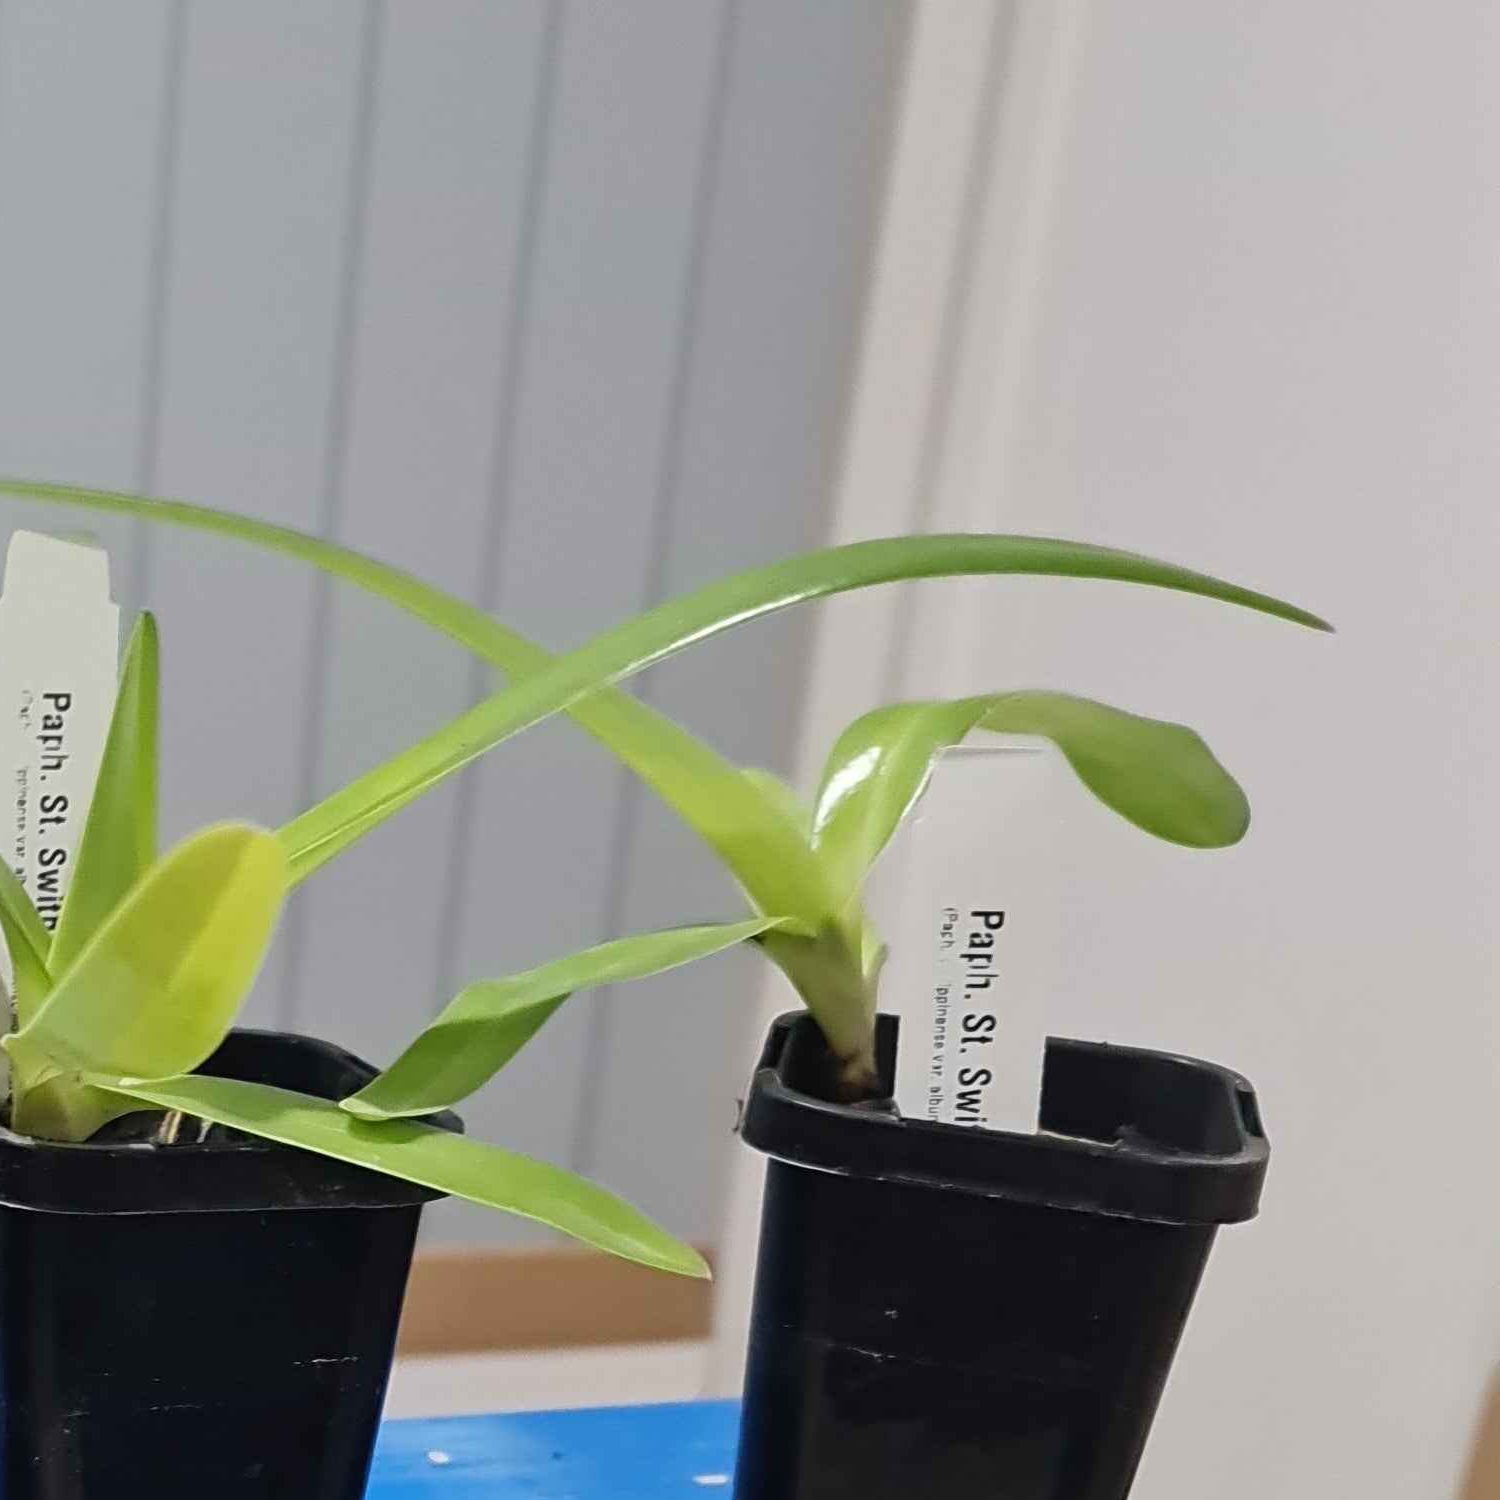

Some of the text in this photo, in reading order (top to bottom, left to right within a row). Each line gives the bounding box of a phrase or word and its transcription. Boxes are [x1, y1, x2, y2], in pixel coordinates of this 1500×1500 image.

[36, 692, 72, 781] Paph.
[38, 795, 69, 835] St.
[959, 910, 1005, 999] Paph.
[960, 1014, 997, 1054] St.
